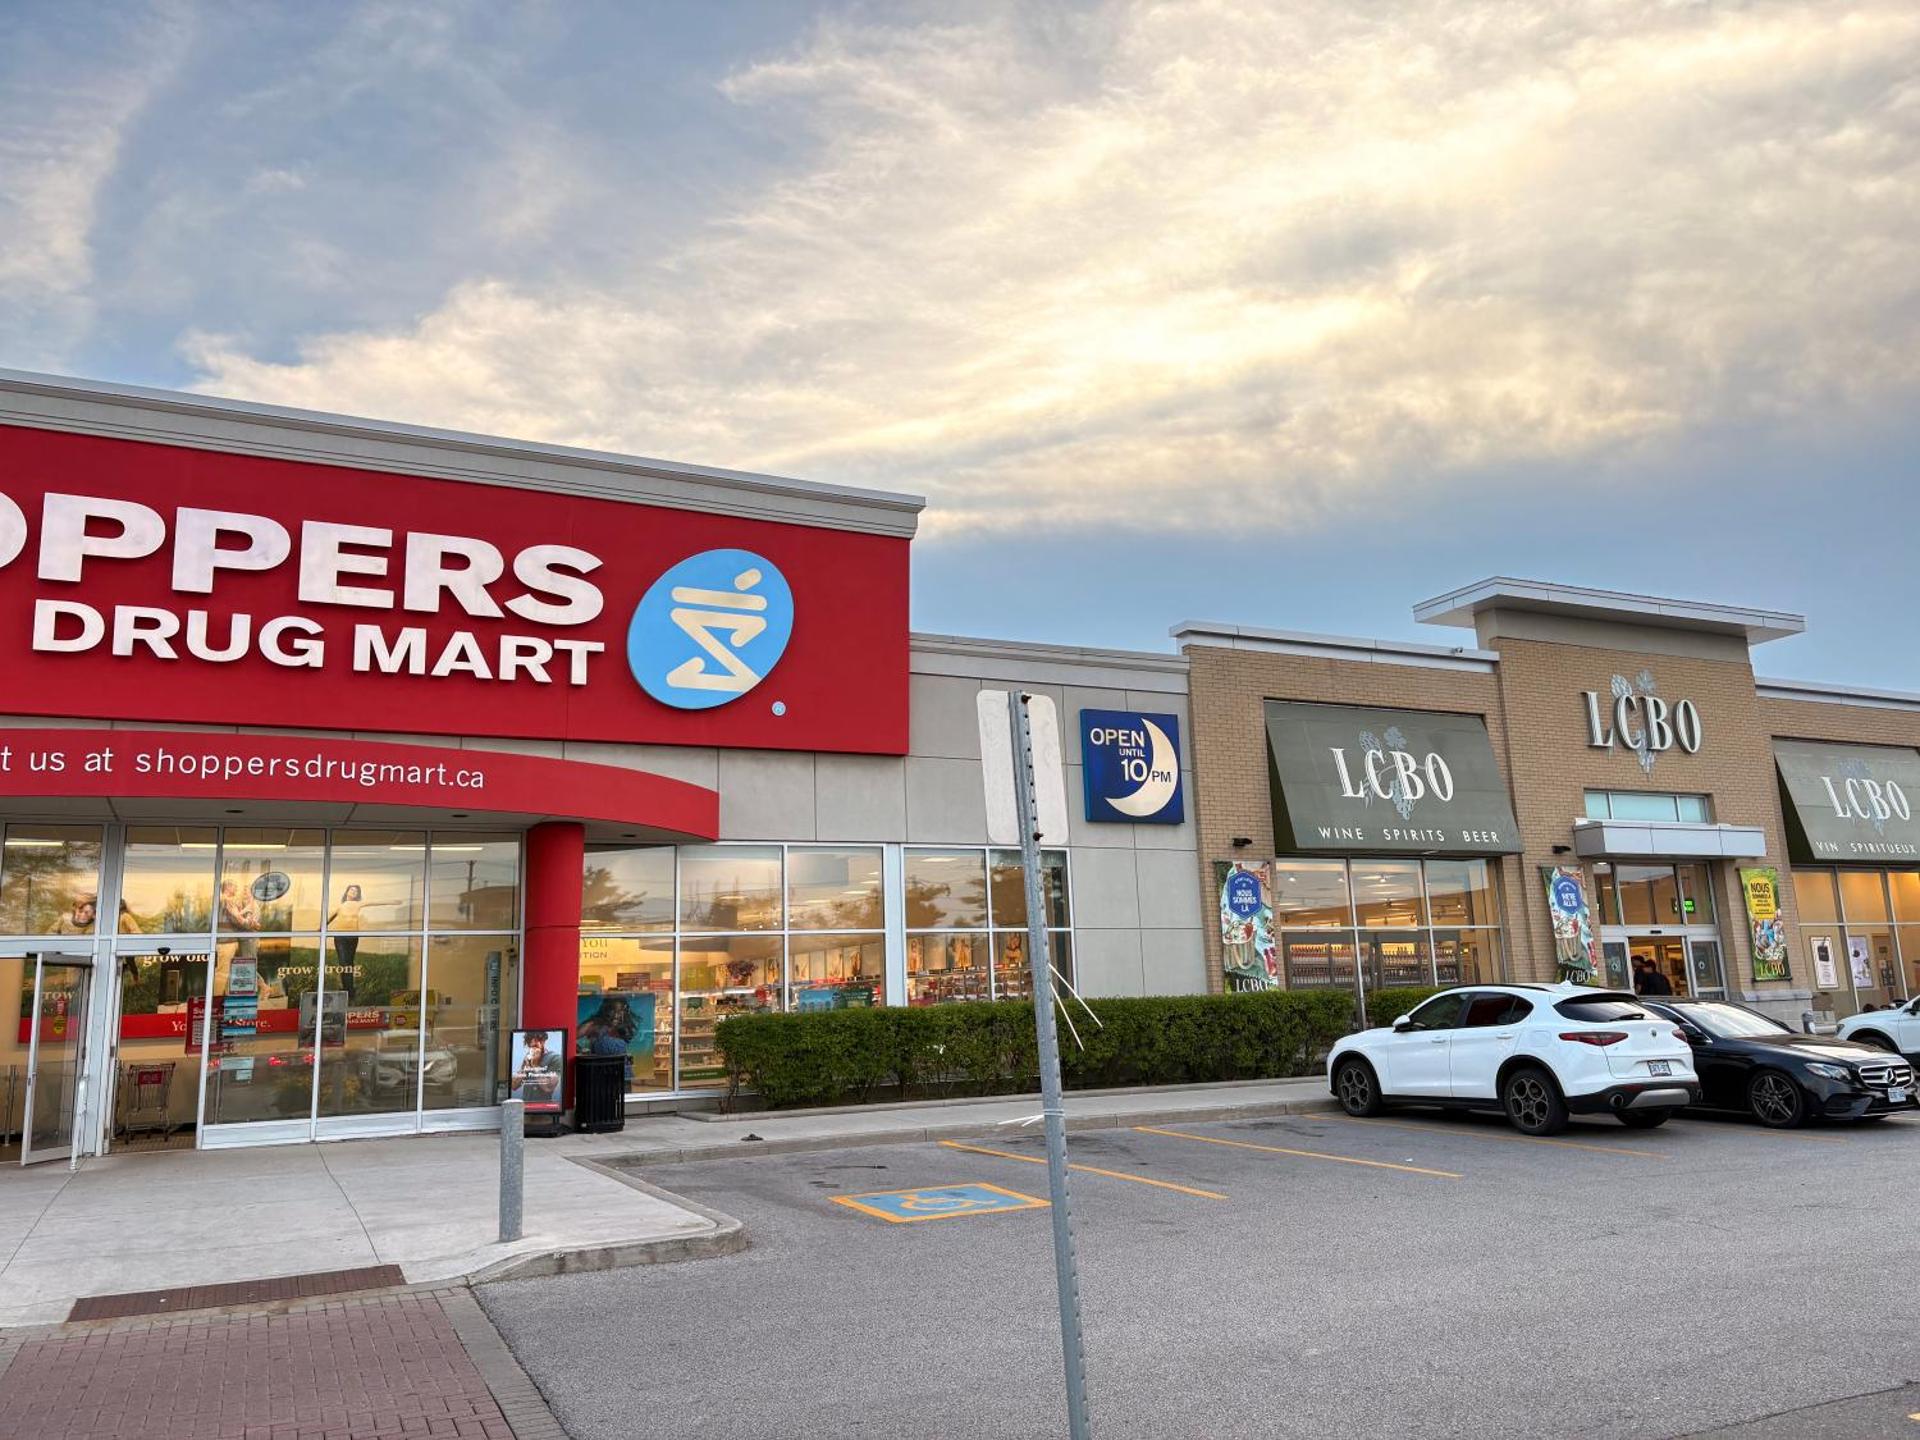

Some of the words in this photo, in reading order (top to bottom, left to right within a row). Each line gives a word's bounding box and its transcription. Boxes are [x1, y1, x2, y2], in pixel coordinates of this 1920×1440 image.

[32, 599, 325, 669] DRUG
[353, 624, 605, 686] MART
[1581, 690, 1703, 755] LCBO
[1090, 728, 1145, 748] OPEN
[1119, 748, 1145, 757] UNTIL
[30, 752, 65, 771] us
[84, 747, 114, 772] at
[135, 748, 484, 789] shoppersdrugmart.ca
[1121, 758, 1148, 781] 10
[1151, 770, 1171, 782] PM
[1330, 747, 1454, 802] LCBO
[1820, 776, 1910, 820] LCBO
[1318, 827, 1364, 840] WINE
[1383, 828, 1445, 842] SPIRITS
[1462, 830, 1500, 844] BEER
[1815, 841, 1839, 852] VIN
[277, 966, 314, 979] grow
[317, 964, 363, 977] trong
[42, 991, 75, 1001] row
